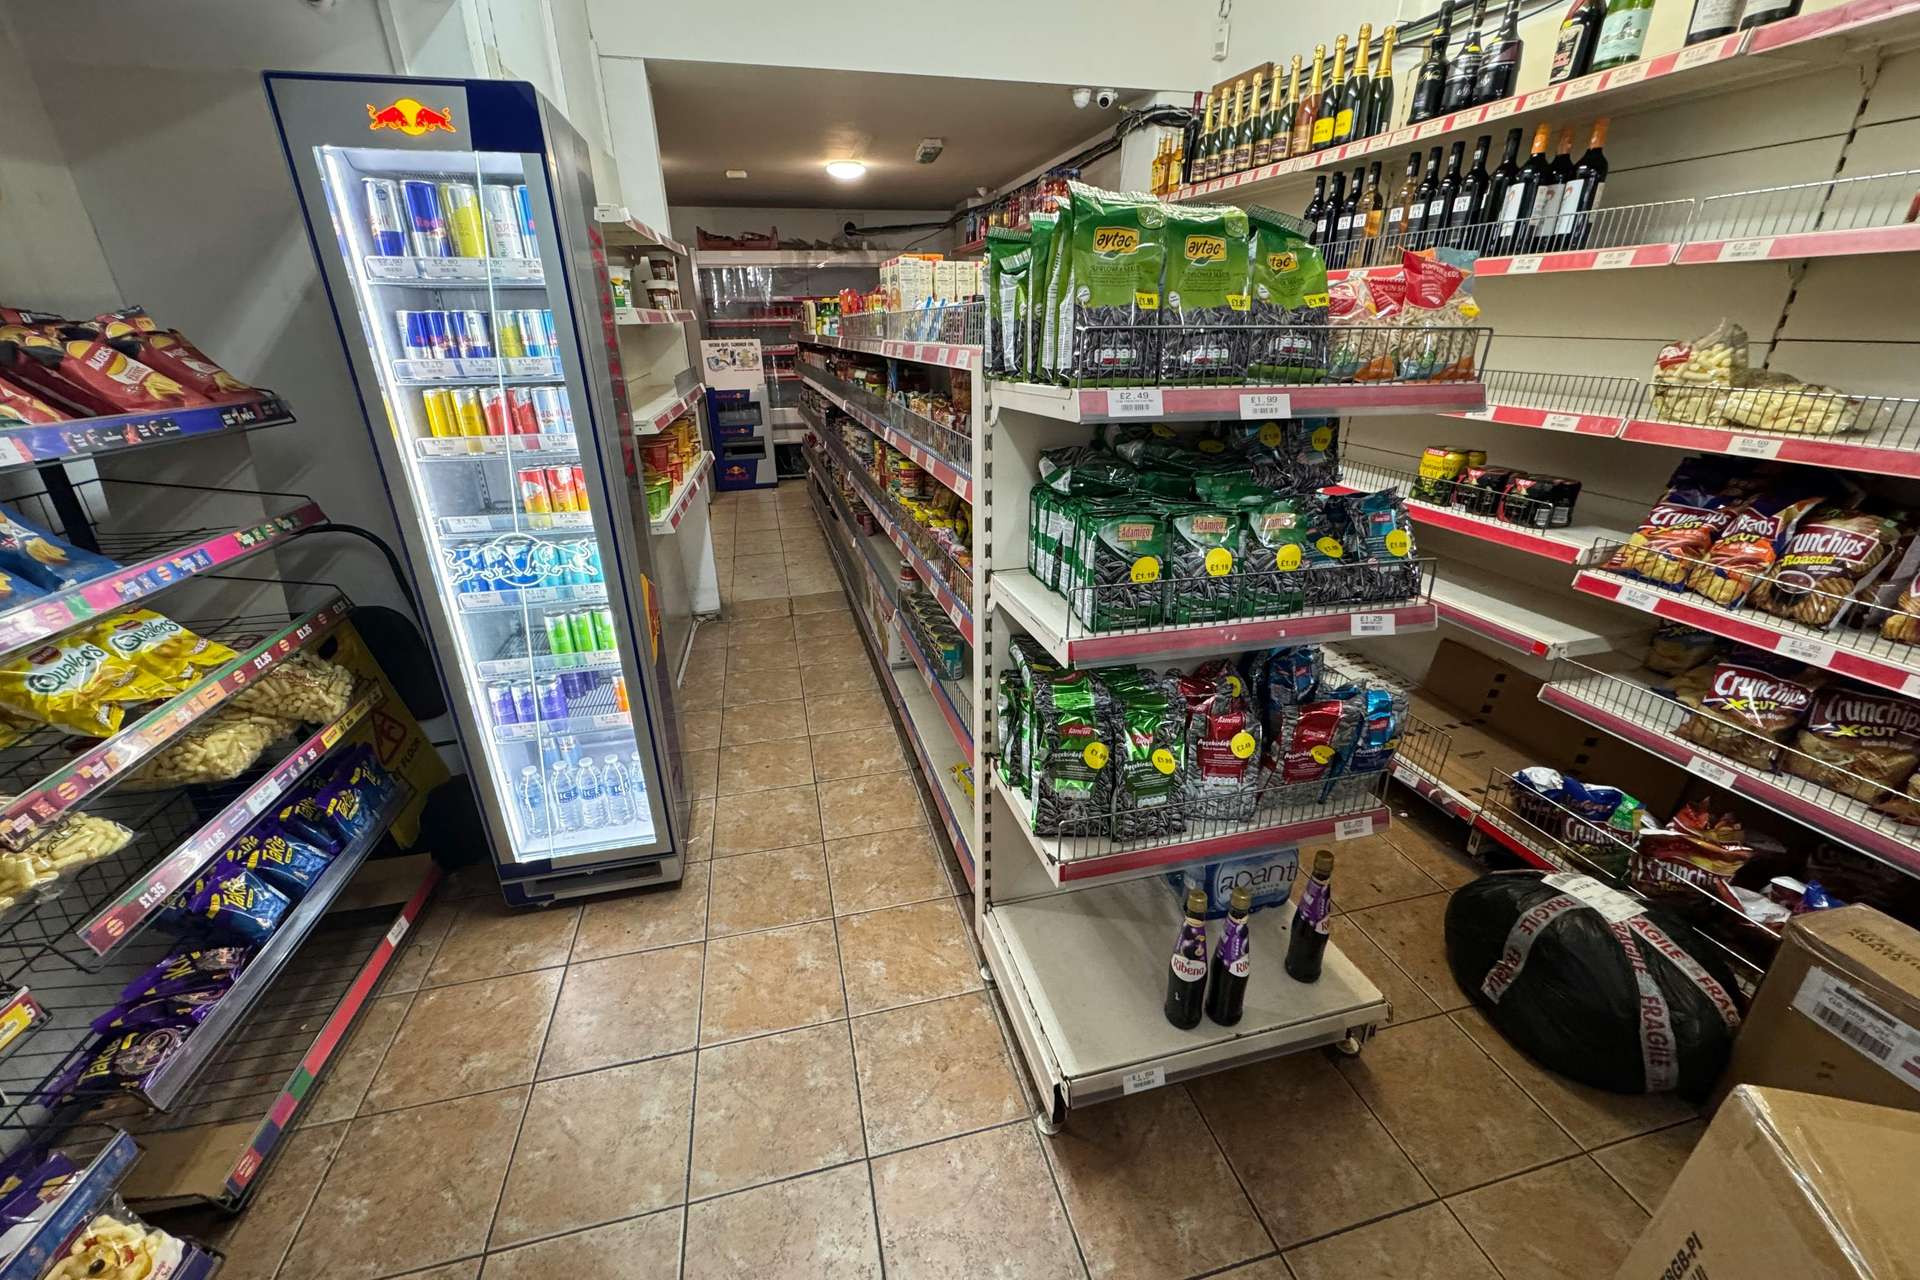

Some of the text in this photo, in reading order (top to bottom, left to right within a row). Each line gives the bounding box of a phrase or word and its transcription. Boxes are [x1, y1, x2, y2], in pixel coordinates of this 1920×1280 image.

[1096, 231, 1133, 249] aytac
[1187, 240, 1222, 256] aytac
[1119, 391, 1149, 401] £2.49
[1121, 526, 1151, 541] Adamigo
[1193, 518, 1225, 532] Adamigo
[1135, 571, 1155, 580] £1.19
[111, 618, 180, 652] Quavers
[27, 643, 106, 693] Quavers
[1829, 724, 1898, 738] X-CUT
[261, 834, 286, 865] Takis
[138, 881, 168, 909] £1.35
[1518, 896, 1577, 937] FRAGILE
[1631, 914, 1686, 962] AGILE
[1172, 958, 1205, 976] Ribena
[1235, 961, 1249, 974] Rib
[1696, 973, 1741, 1026] FRAG
[1640, 994, 1672, 1068] FRAGILE
